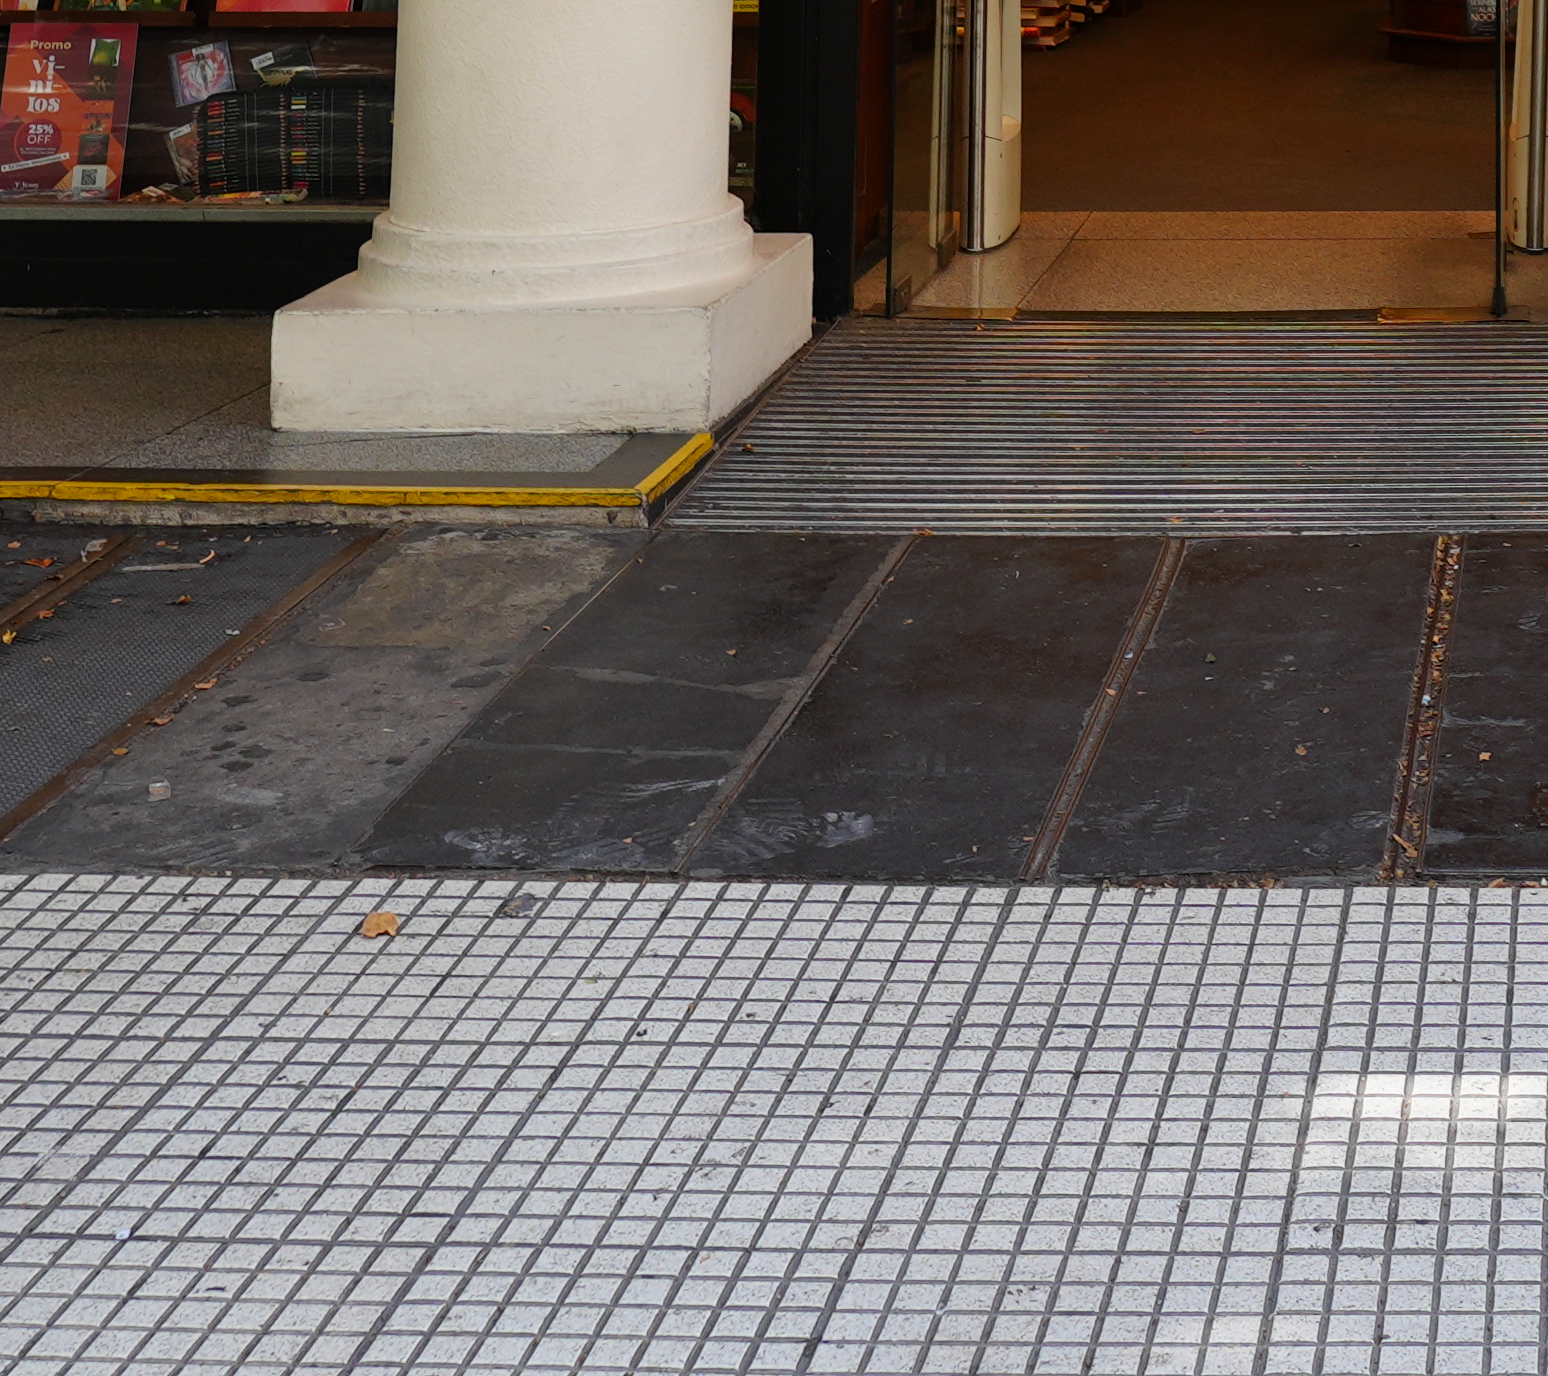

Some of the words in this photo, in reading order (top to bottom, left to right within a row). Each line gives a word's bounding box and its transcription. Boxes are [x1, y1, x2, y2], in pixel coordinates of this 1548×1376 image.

[29, 39, 73, 51] Promo
[28, 123, 54, 136] 25%
[26, 134, 52, 146] OFF
